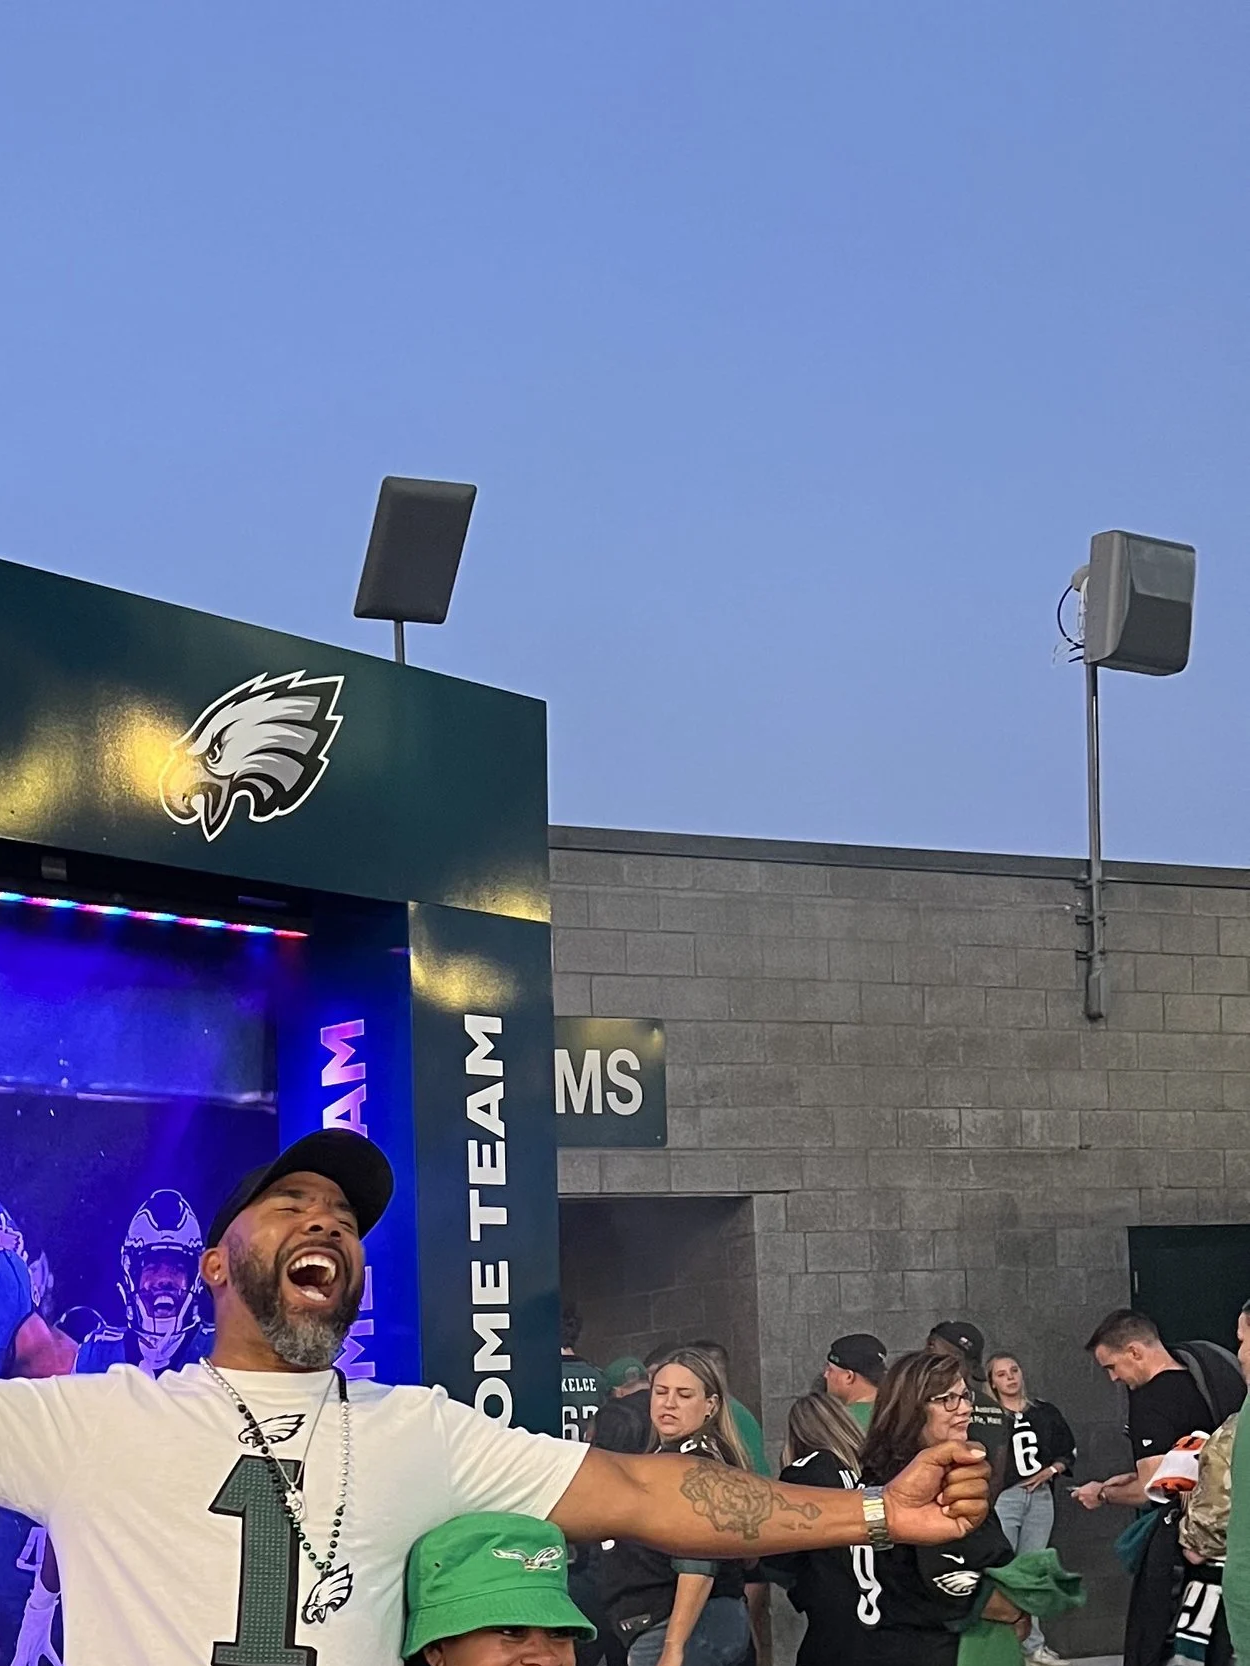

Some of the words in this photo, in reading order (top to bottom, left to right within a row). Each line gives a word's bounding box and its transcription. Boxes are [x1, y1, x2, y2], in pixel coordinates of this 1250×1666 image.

[320, 1018, 369, 1139] AM
[464, 1013, 508, 1242] TEAM
[553, 1048, 644, 1116] MS
[471, 1260, 513, 1429] OME
[561, 1377, 598, 1393] KELCE
